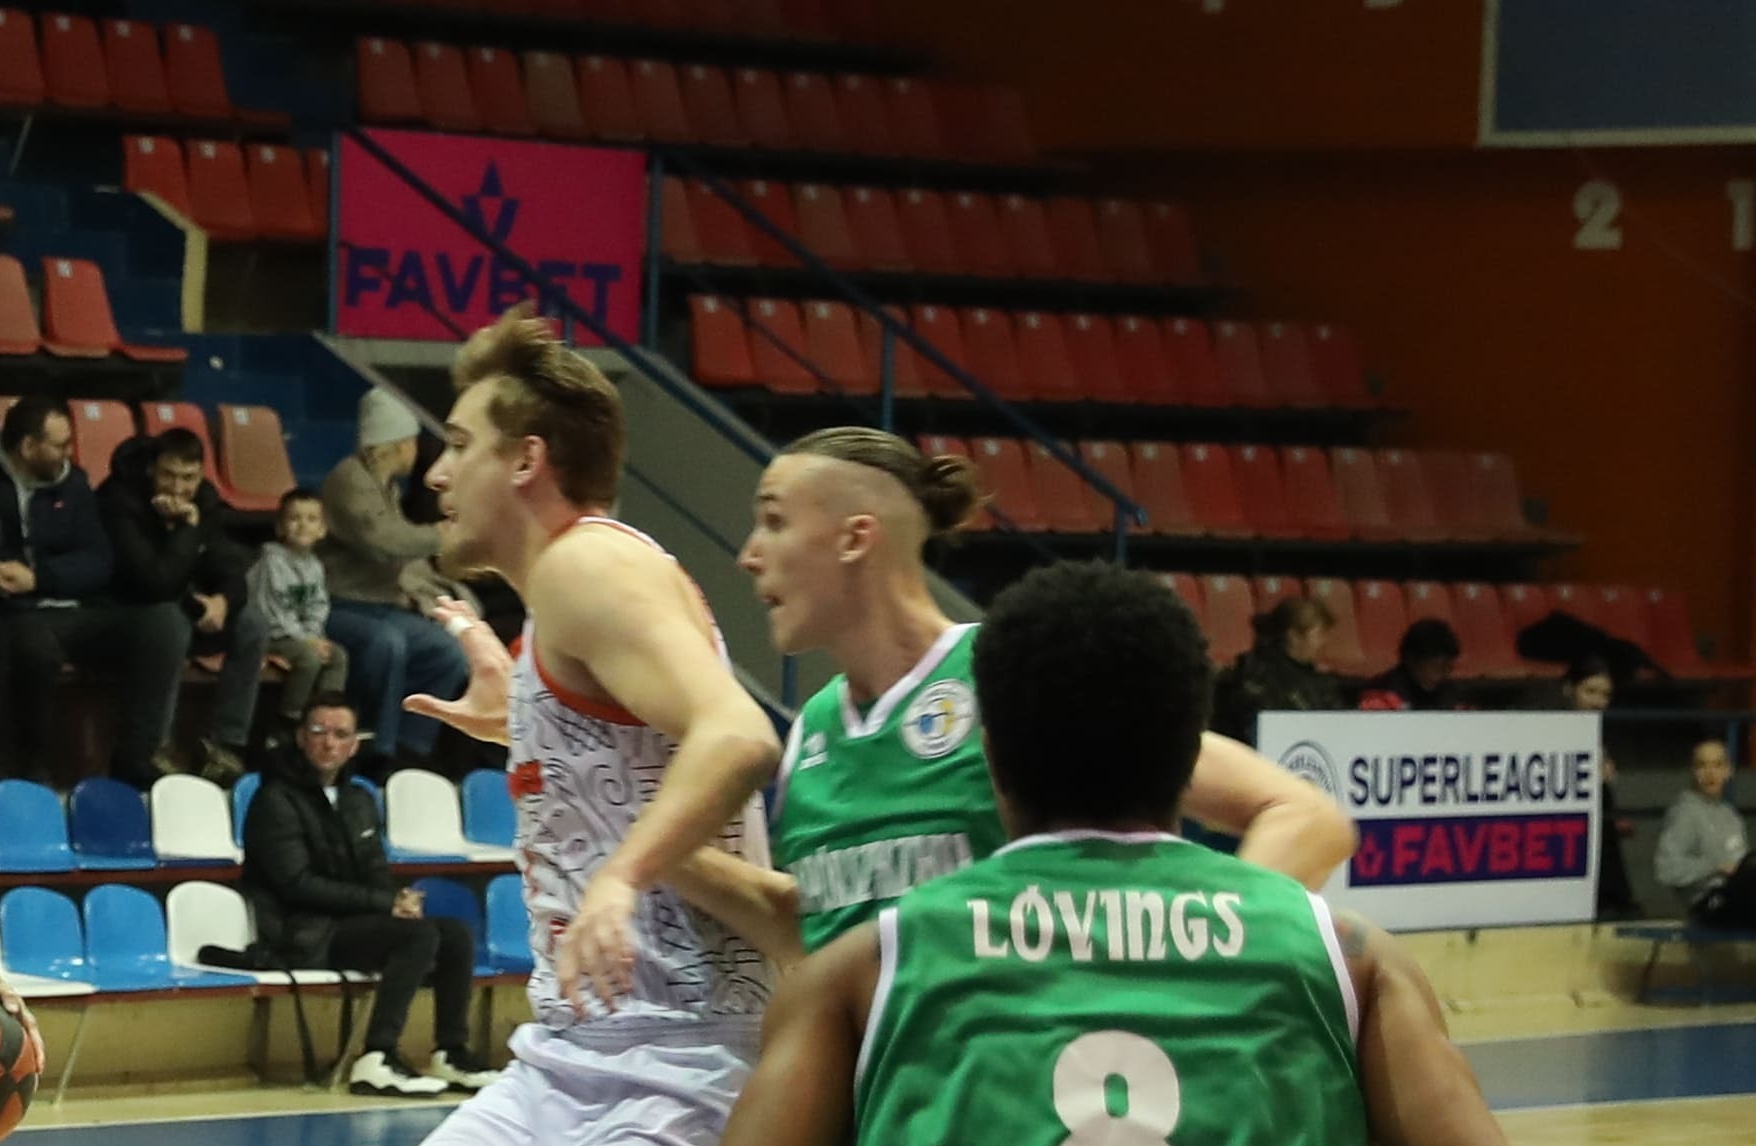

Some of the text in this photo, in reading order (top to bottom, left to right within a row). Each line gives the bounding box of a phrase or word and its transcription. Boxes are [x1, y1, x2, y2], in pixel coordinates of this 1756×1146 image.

[1572, 179, 1623, 251] 2
[1347, 751, 1591, 807] SUPERLEAGUE
[1391, 819, 1587, 877] FAVBET
[966, 885, 1245, 962] LOVINGS
